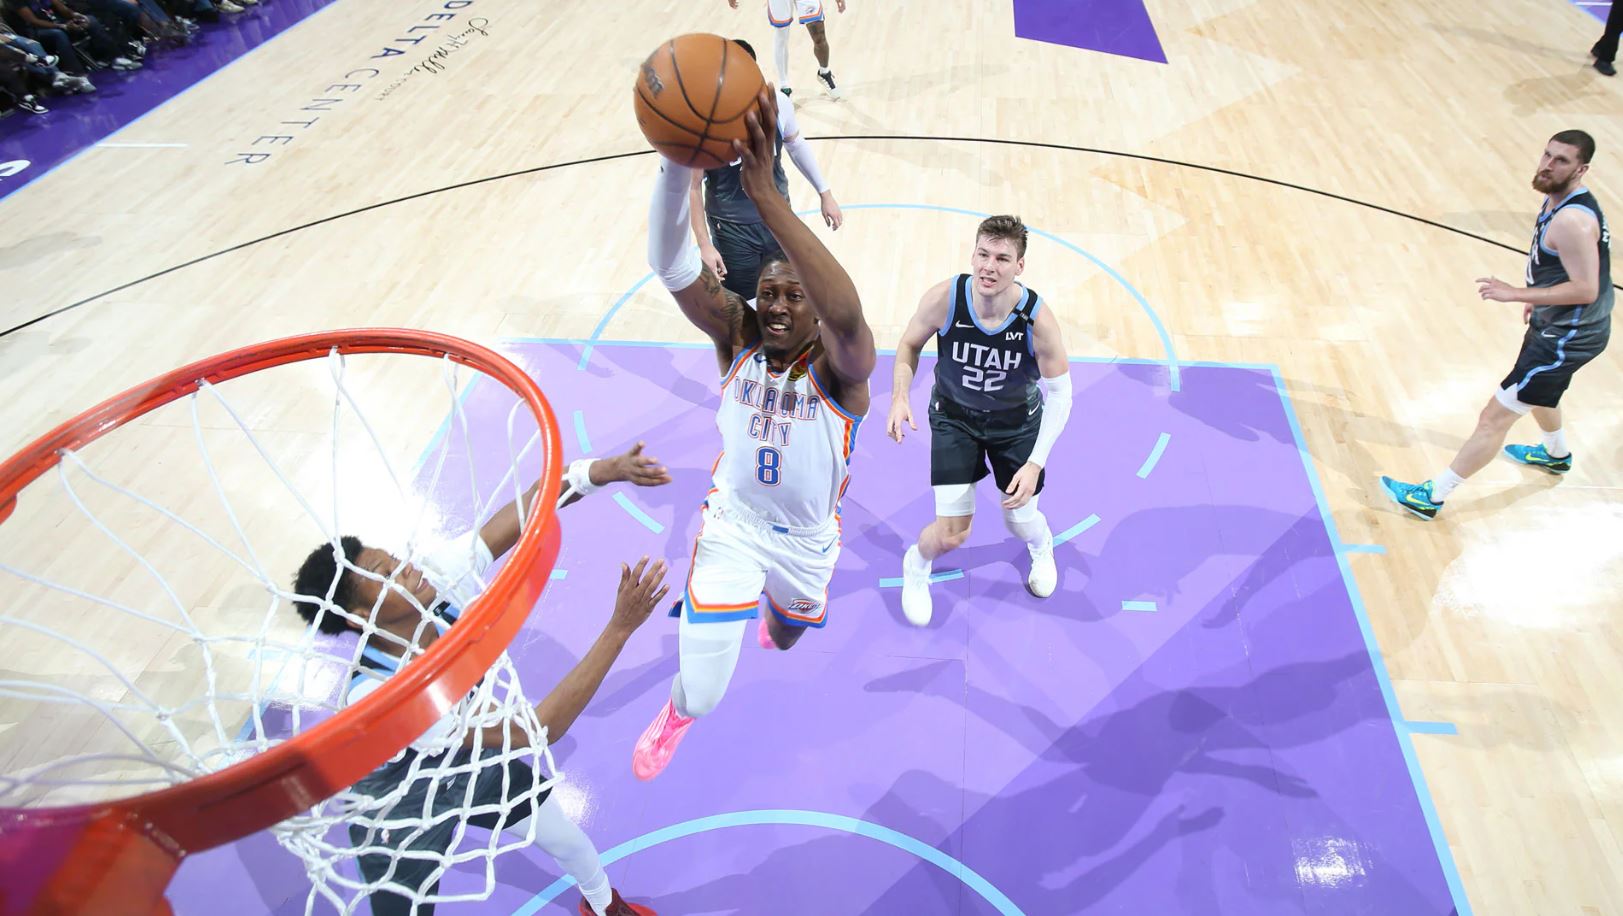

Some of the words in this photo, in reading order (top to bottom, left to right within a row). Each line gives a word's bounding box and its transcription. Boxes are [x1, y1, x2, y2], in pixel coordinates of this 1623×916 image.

[371, 0, 473, 60] DELTA
[224, 67, 380, 165] CENTER
[1005, 331, 1024, 341] LVT
[952, 341, 1022, 371] UTAH
[962, 366, 1007, 392] 22
[735, 376, 820, 421] OKLAOMA
[747, 413, 791, 446] CITY
[755, 446, 782, 486] 8
